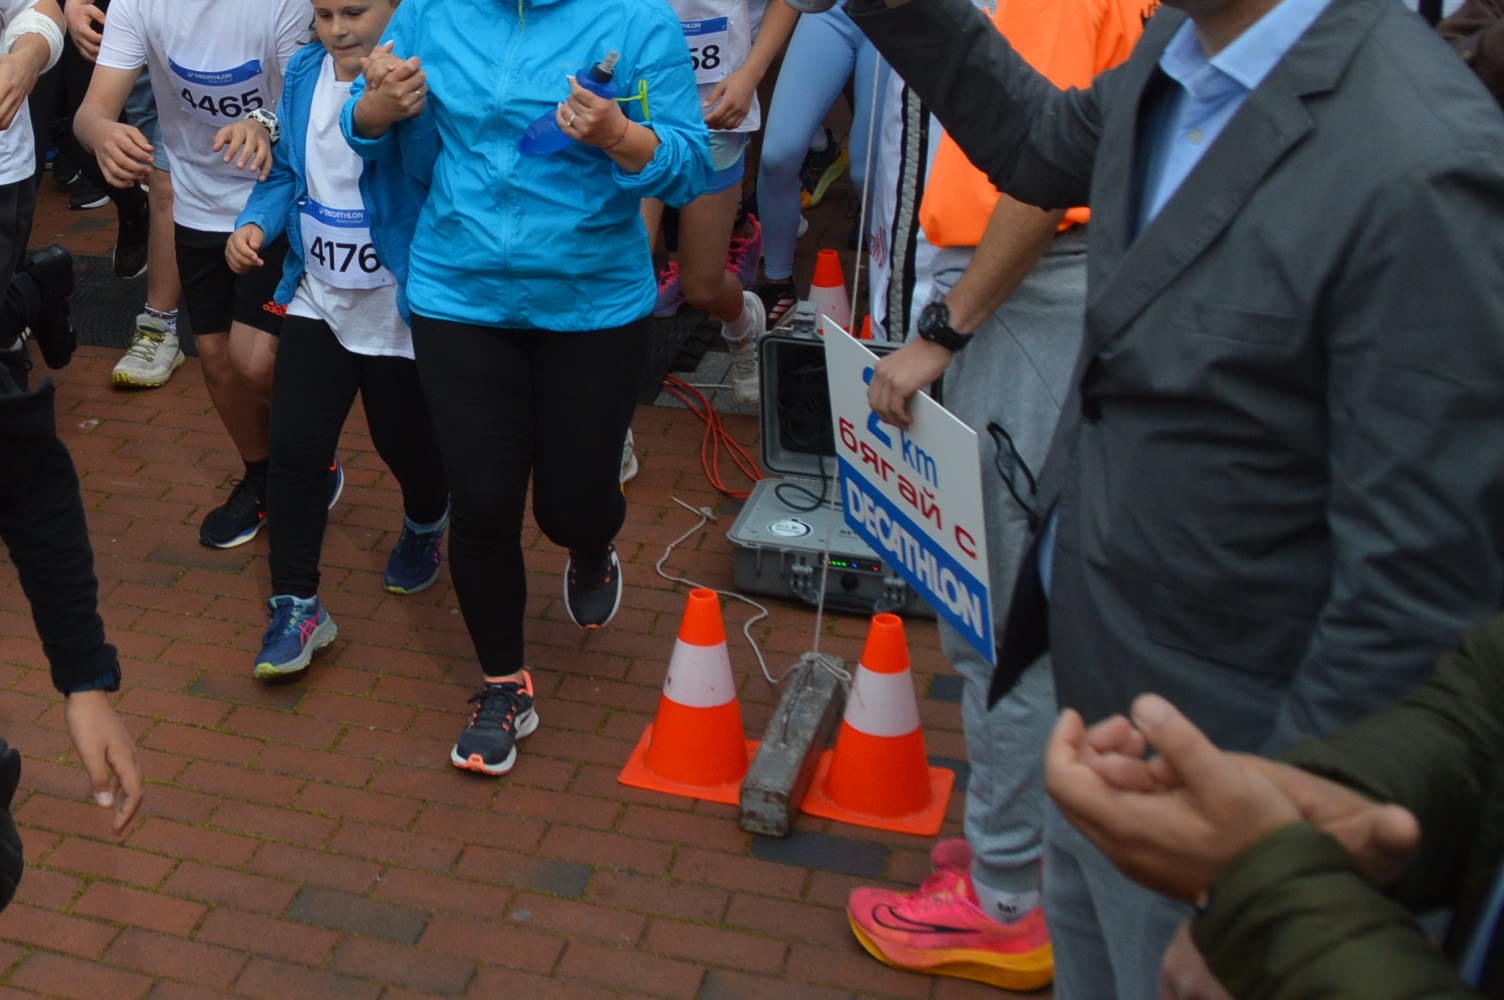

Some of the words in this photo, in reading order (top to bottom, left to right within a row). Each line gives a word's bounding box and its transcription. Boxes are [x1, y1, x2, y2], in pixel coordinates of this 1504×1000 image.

[181, 88, 264, 118] 4465
[324, 207, 364, 219] DECATHLON
[310, 236, 382, 273] 4176
[839, 418, 942, 531] бягай
[901, 426, 939, 488] km
[846, 478, 984, 637] DECATHLON
